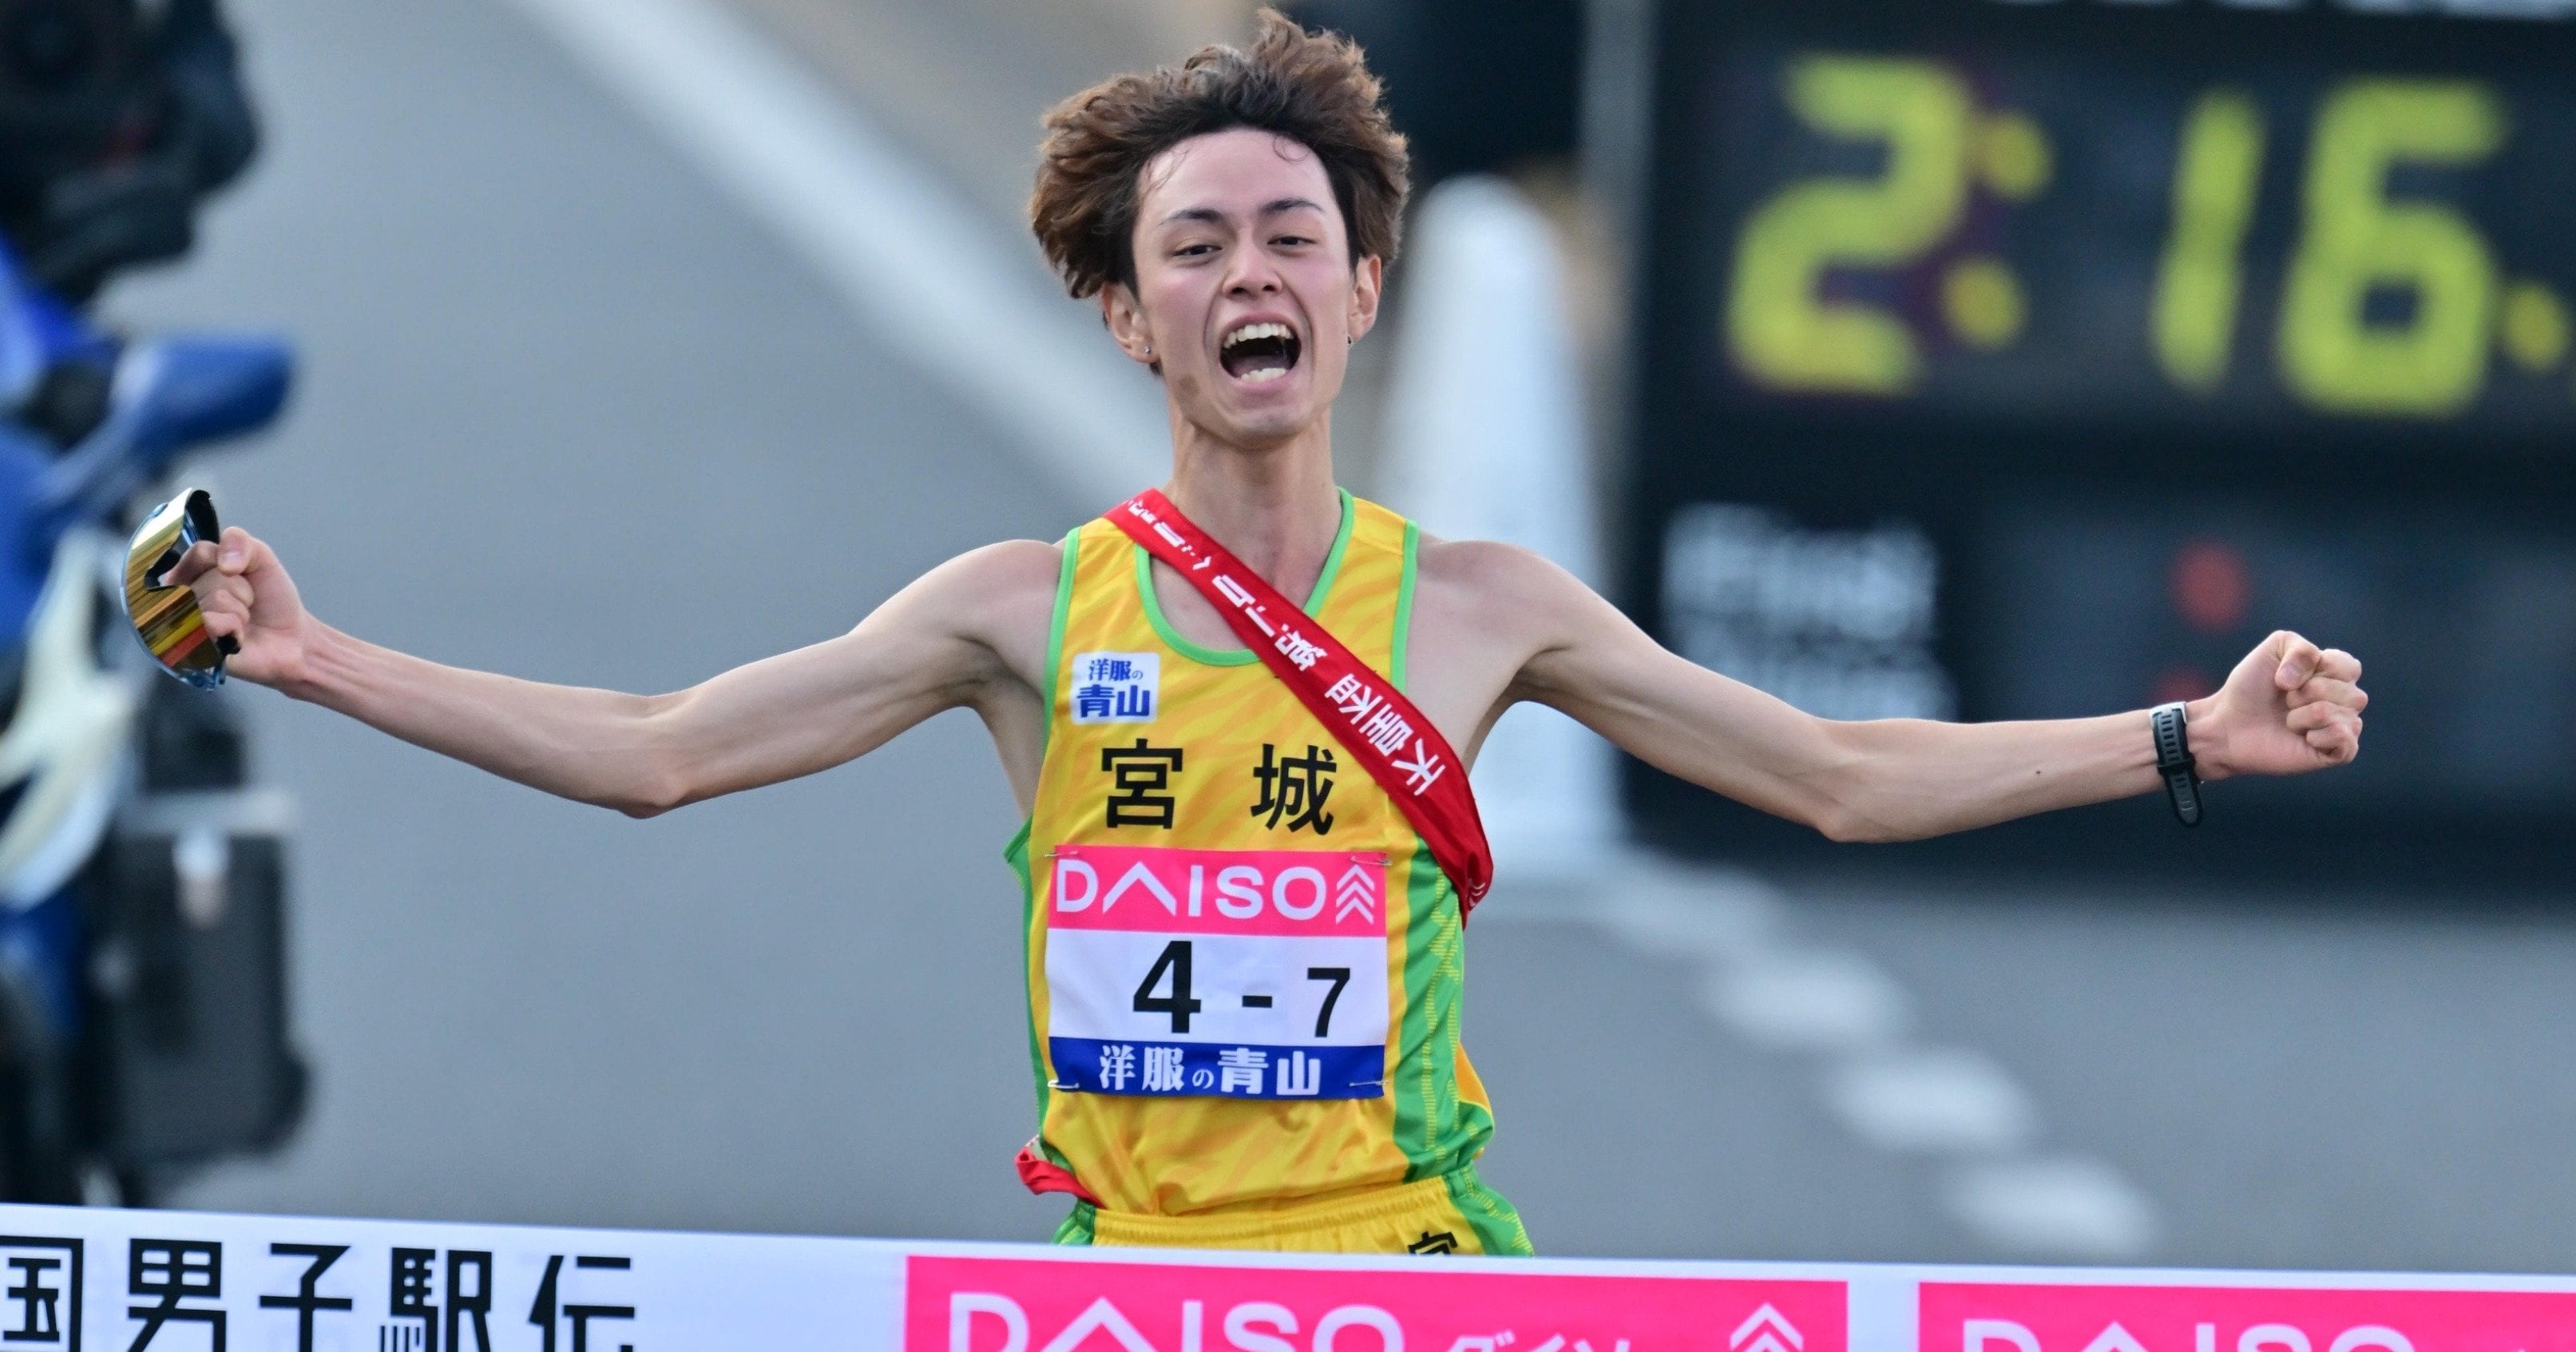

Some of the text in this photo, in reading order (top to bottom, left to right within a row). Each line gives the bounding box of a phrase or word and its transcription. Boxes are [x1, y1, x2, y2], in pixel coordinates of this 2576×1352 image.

[1088, 658, 1143, 682] 洋服の
[1076, 684, 1150, 718] 青山
[1101, 737, 1337, 835] 宮城
[1056, 858, 1327, 921] DAISO
[1099, 1045, 1322, 1096] 洋服の青山
